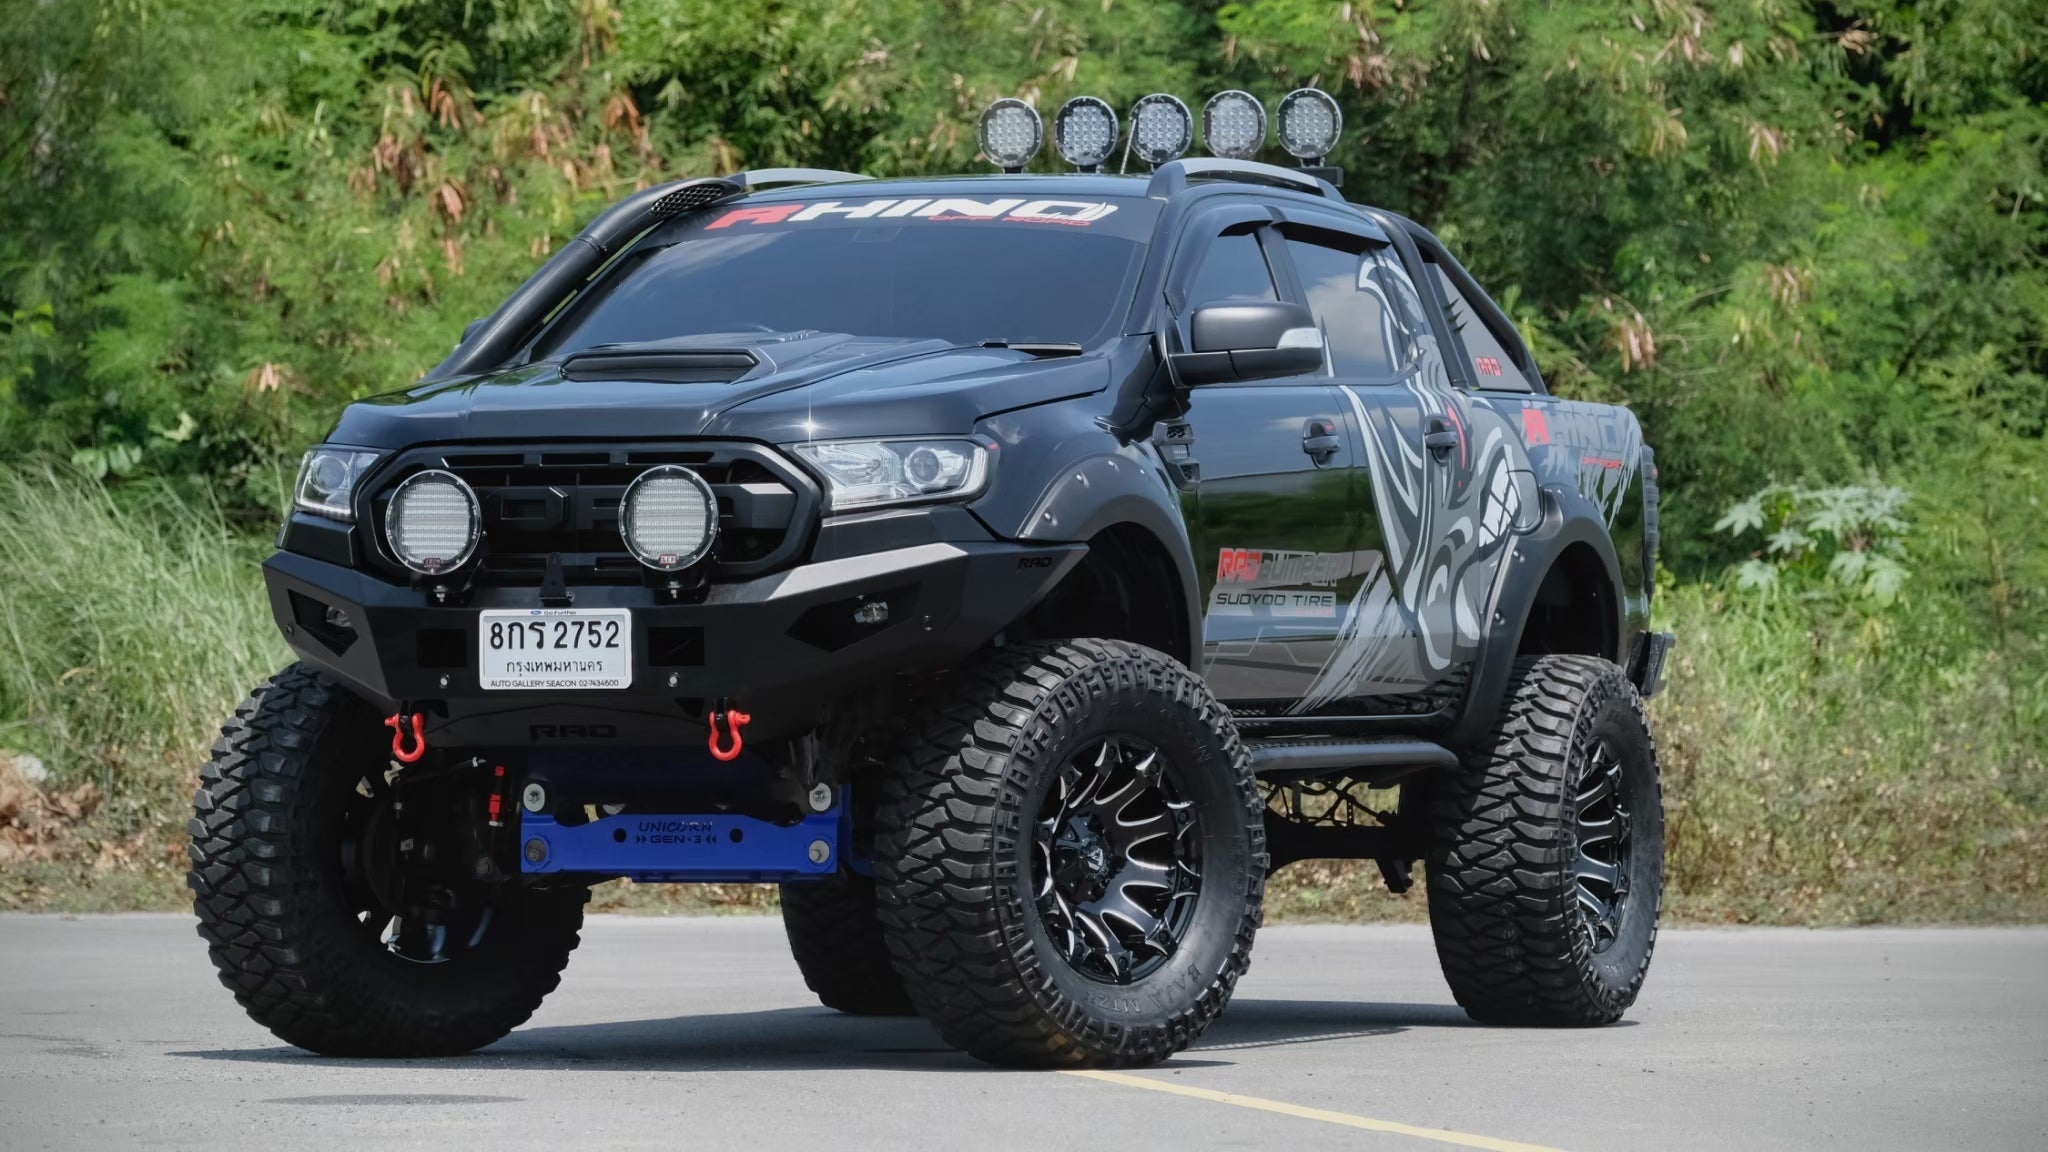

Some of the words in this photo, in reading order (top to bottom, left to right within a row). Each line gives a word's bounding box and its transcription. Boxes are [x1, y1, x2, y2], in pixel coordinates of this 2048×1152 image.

[704, 198, 1118, 230] RHINO
[1293, 595, 1333, 607] TIRE
[490, 621, 546, 650] 8กร
[553, 620, 619, 649] 2752
[506, 659, 603, 677] กรุงเทพมหานคร
[490, 680, 511, 688] AUTO
[512, 679, 545, 688] GALLERY
[579, 679, 619, 687] 02-7434600
[639, 821, 713, 832] UNICORN
